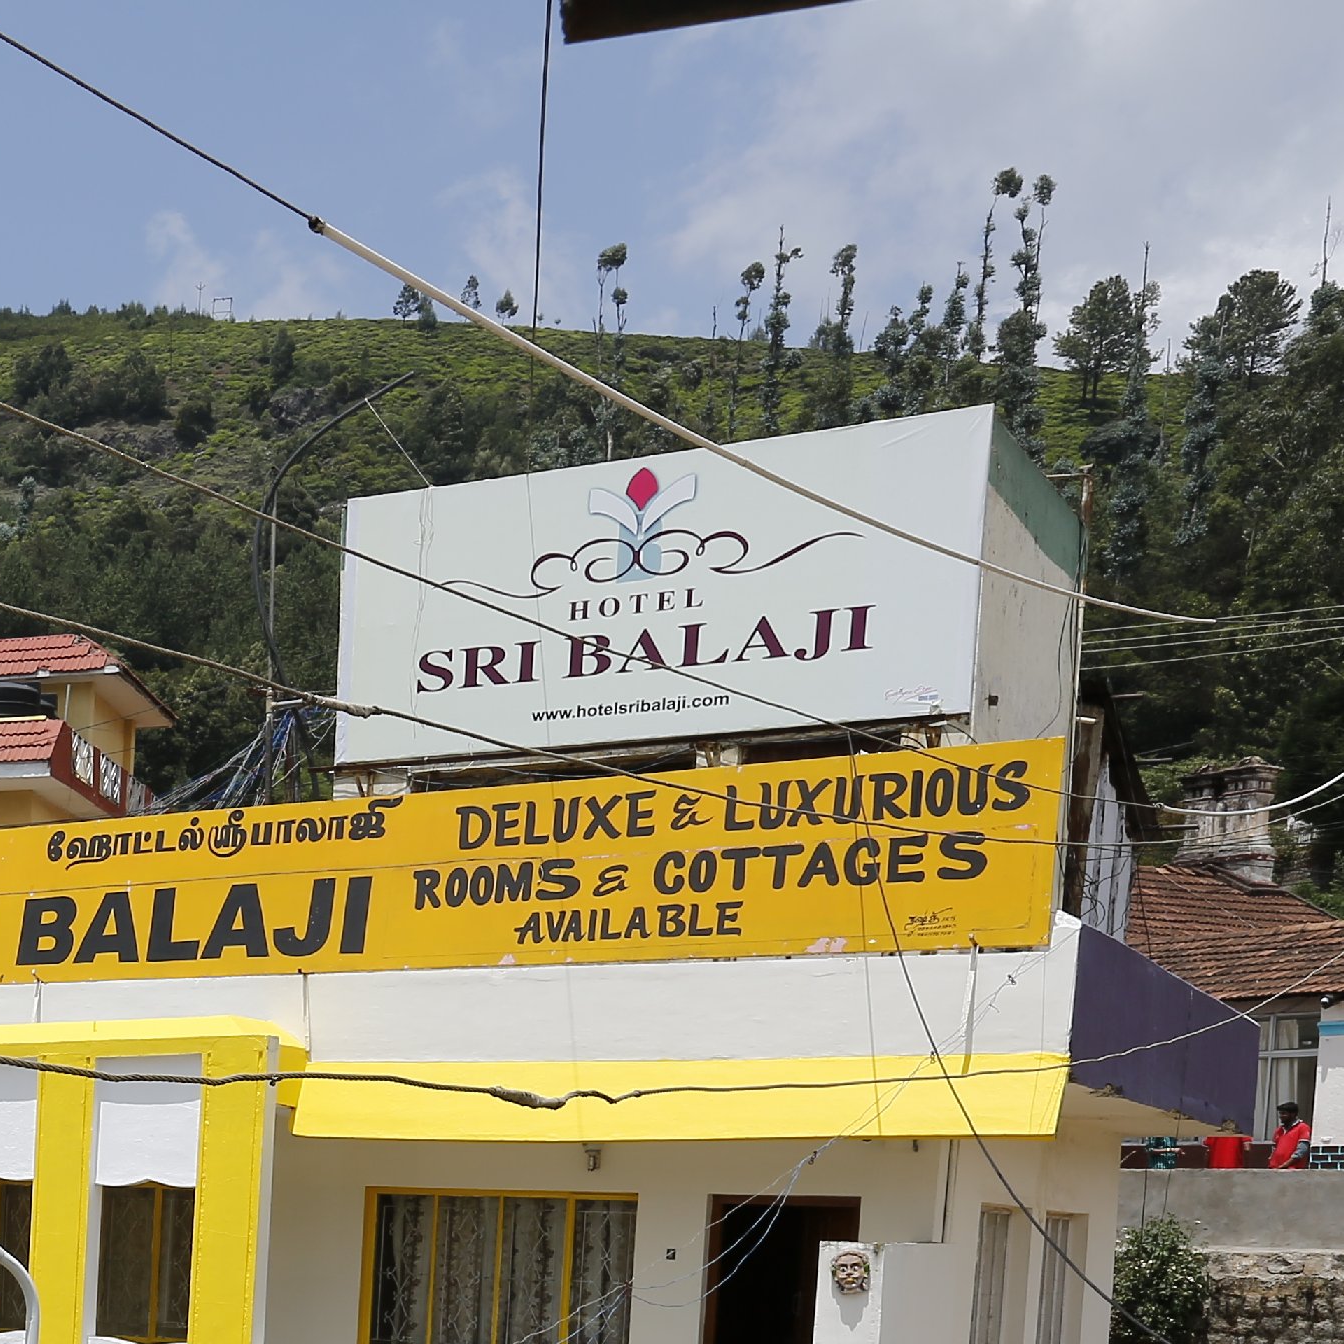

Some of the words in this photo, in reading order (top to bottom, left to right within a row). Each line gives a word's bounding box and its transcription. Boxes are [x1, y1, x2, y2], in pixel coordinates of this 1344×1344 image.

[568, 588, 705, 622] HOTEL
[416, 639, 543, 695] SRI
[562, 604, 878, 680] BALAJI
[531, 693, 731, 723] www.hotelsribalaji.com
[457, 789, 657, 851] DELUXE
[670, 793, 714, 832] &
[724, 760, 1031, 833] LUXURIOUS
[413, 857, 582, 911] ROOMS
[593, 864, 630, 897] &
[653, 831, 989, 895] COTTAGES
[16, 876, 374, 967] BALAJI
[513, 901, 744, 946] AVAILABLE
